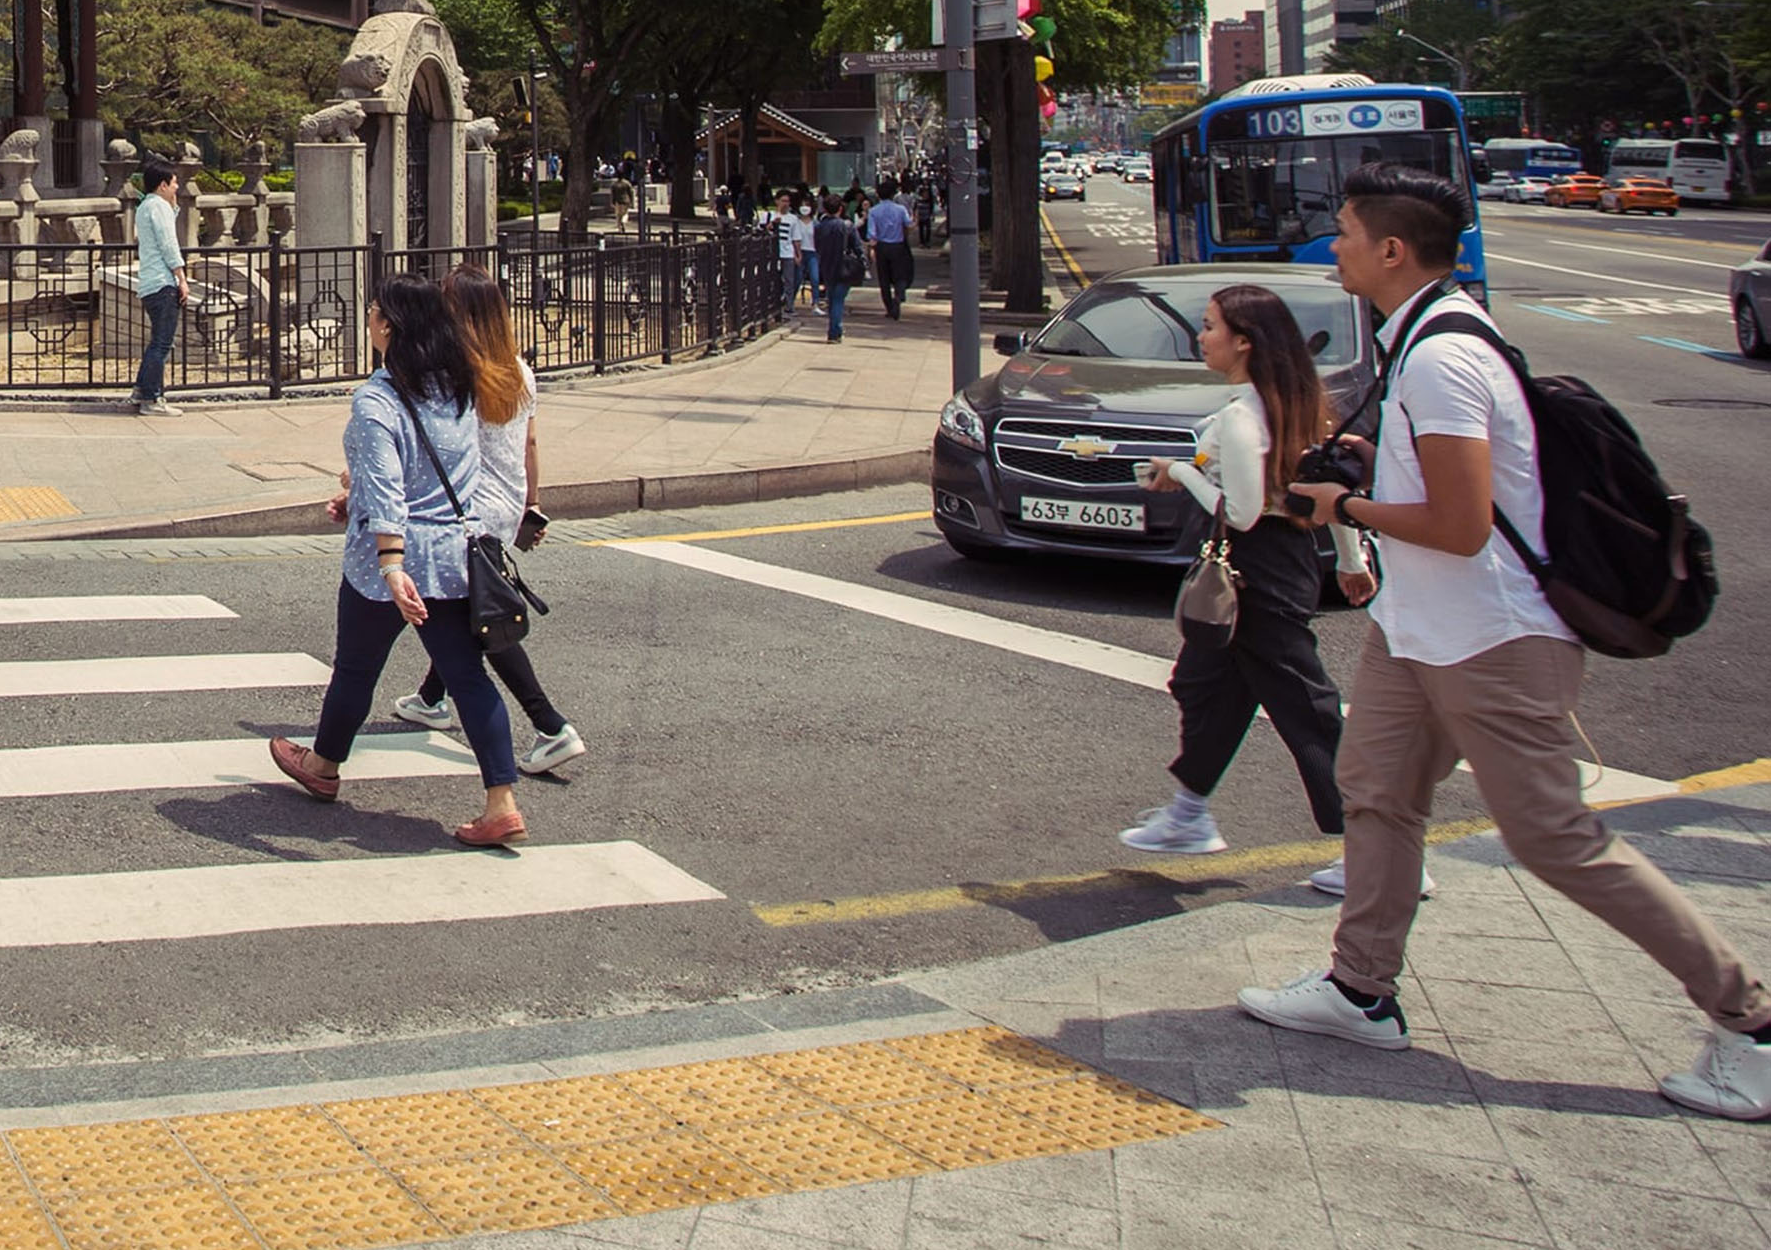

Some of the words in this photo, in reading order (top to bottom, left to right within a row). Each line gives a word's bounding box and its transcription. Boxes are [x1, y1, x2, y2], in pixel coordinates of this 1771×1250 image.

[1249, 108, 1300, 136] 103
[1030, 501, 1070, 521] 63부
[1079, 507, 1134, 527] 6603
